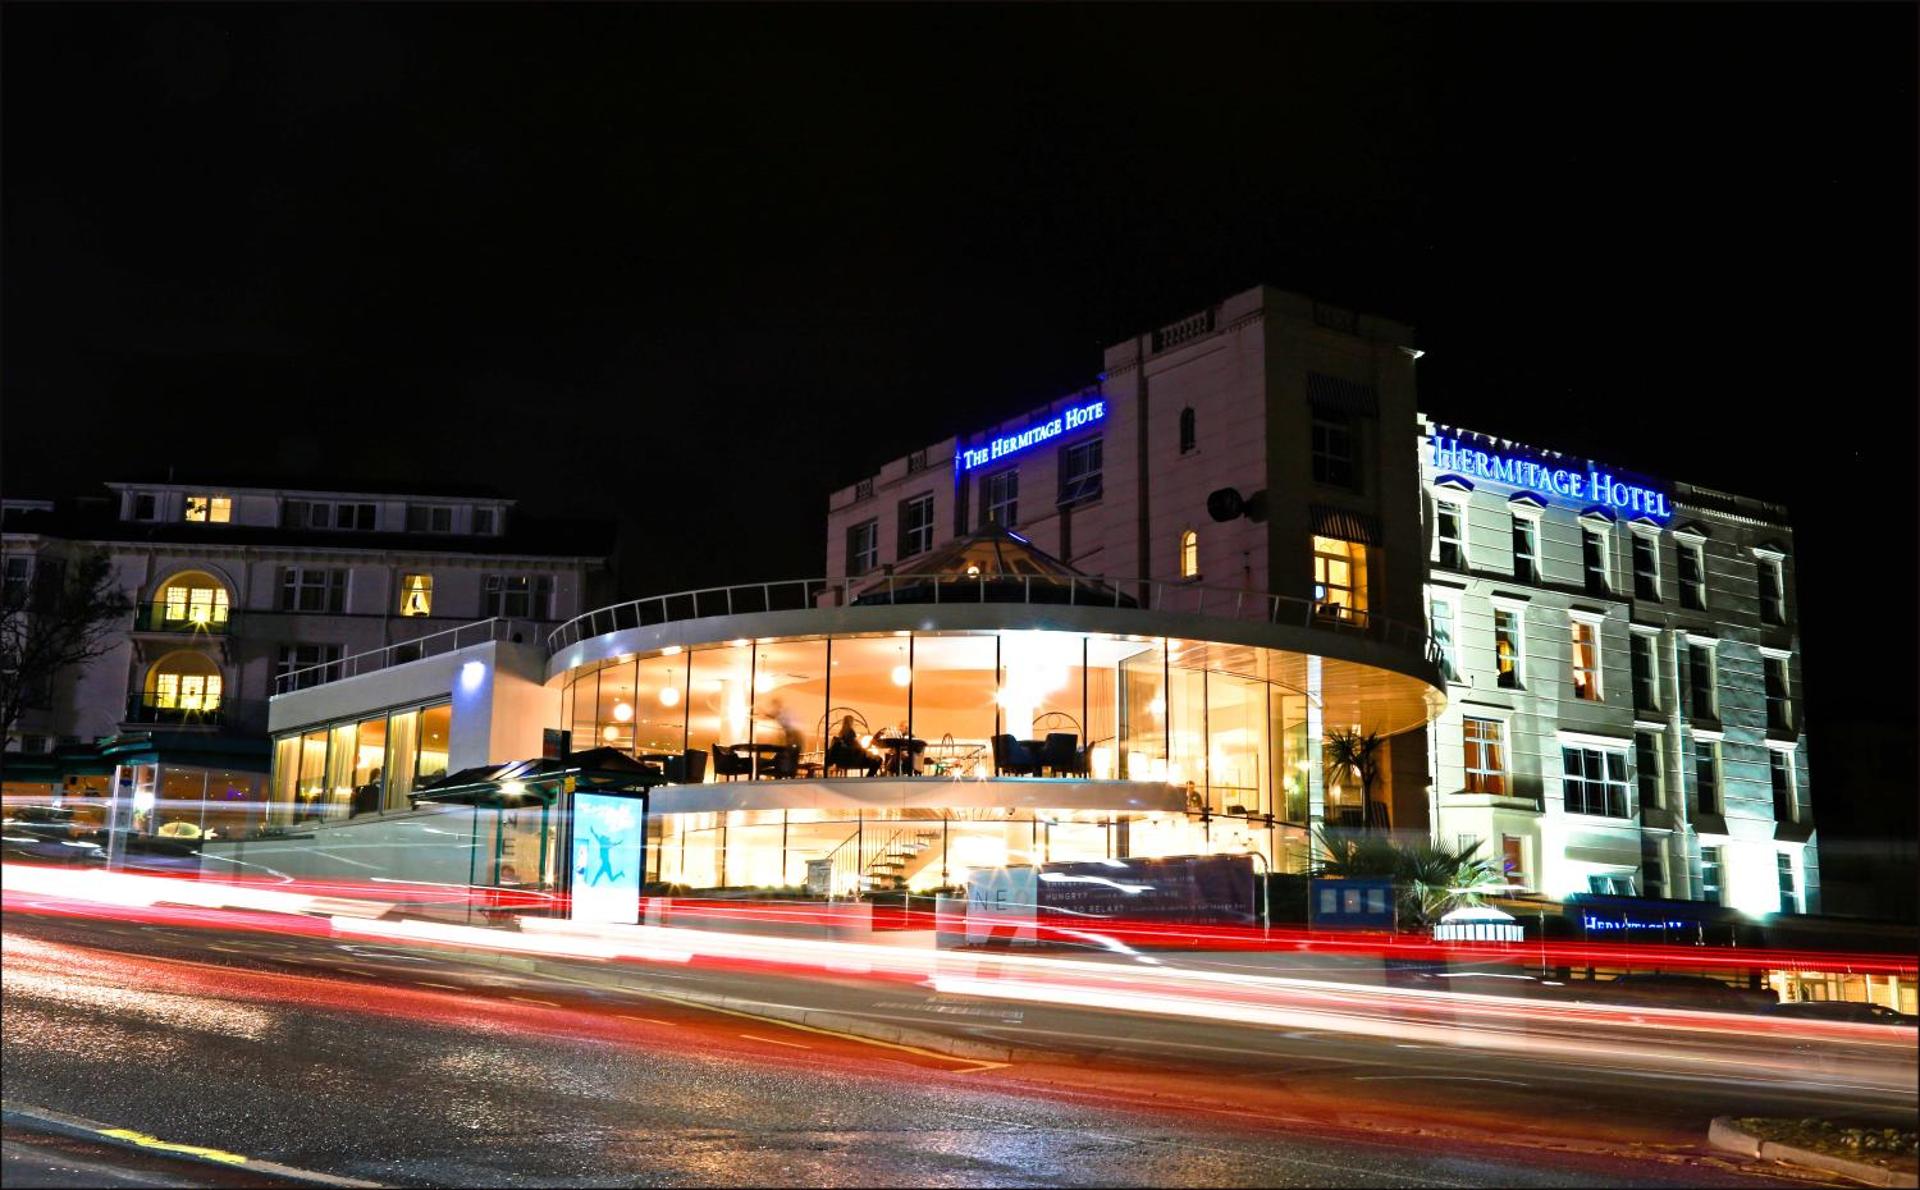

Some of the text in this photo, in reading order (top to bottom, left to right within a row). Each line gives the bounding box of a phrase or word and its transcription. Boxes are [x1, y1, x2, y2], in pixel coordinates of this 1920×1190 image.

[963, 400, 1106, 470] THE HERMITAGE HOTE
[1433, 435, 1671, 518] HERMITAGE HOTEL
